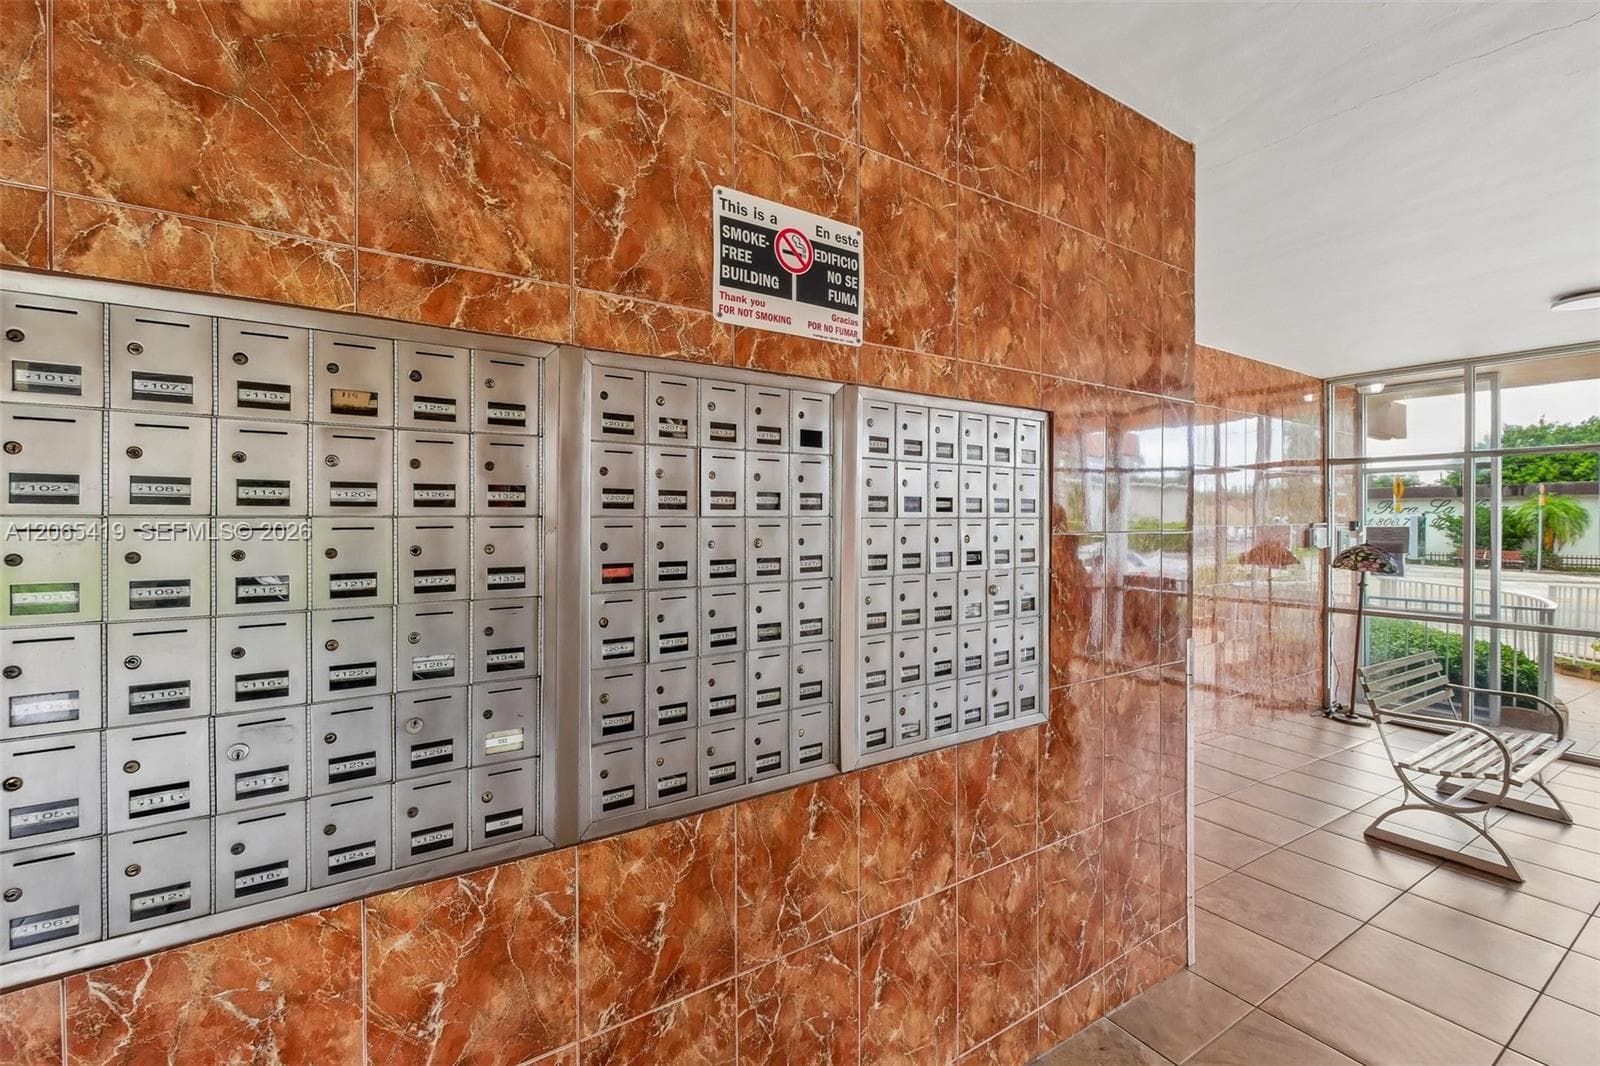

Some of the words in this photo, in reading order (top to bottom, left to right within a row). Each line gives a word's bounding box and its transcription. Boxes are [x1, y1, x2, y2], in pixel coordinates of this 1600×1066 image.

[719, 198, 748, 216] This
[754, 207, 764, 221] is
[770, 215, 777, 225] a
[722, 225, 770, 247] SMOKE-
[816, 225, 830, 239] En
[835, 232, 859, 248] este
[722, 245, 752, 264] FREE
[814, 250, 858, 271] EDIFICIO
[722, 265, 780, 289] BUILDING
[827, 271, 842, 286] NO
[845, 276, 858, 289] SE
[719, 291, 747, 304] Thank
[750, 298, 765, 308] you
[828, 290, 857, 307] FUMA
[719, 304, 735, 315] FOR
[738, 308, 753, 318] NOT
[756, 311, 791, 325] SMOKING
[832, 314, 858, 326] Gracias
[808, 321, 821, 330] POR
[824, 324, 833, 334] NO
[835, 326, 858, 338] FUMAR
[34, 373, 65, 383] 101
[151, 382, 179, 391] 107
[253, 391, 278, 399] 113
[28, 484, 62, 493] 102
[147, 485, 176, 494] 108
[146, 588, 175, 597] 109
[342, 669, 364, 677] 122
[250, 680, 275, 688] 116
[151, 689, 177, 699] 110
[423, 749, 442, 757] 129
[342, 760, 363, 768] 123
[250, 777, 277, 786] 117
[148, 795, 177, 805] 111
[33, 811, 65, 821] 105
[423, 834, 443, 842] 130
[342, 850, 364, 861] 124
[249, 872, 274, 884] 118
[150, 892, 177, 904] 112
[32, 920, 62, 931] 106
